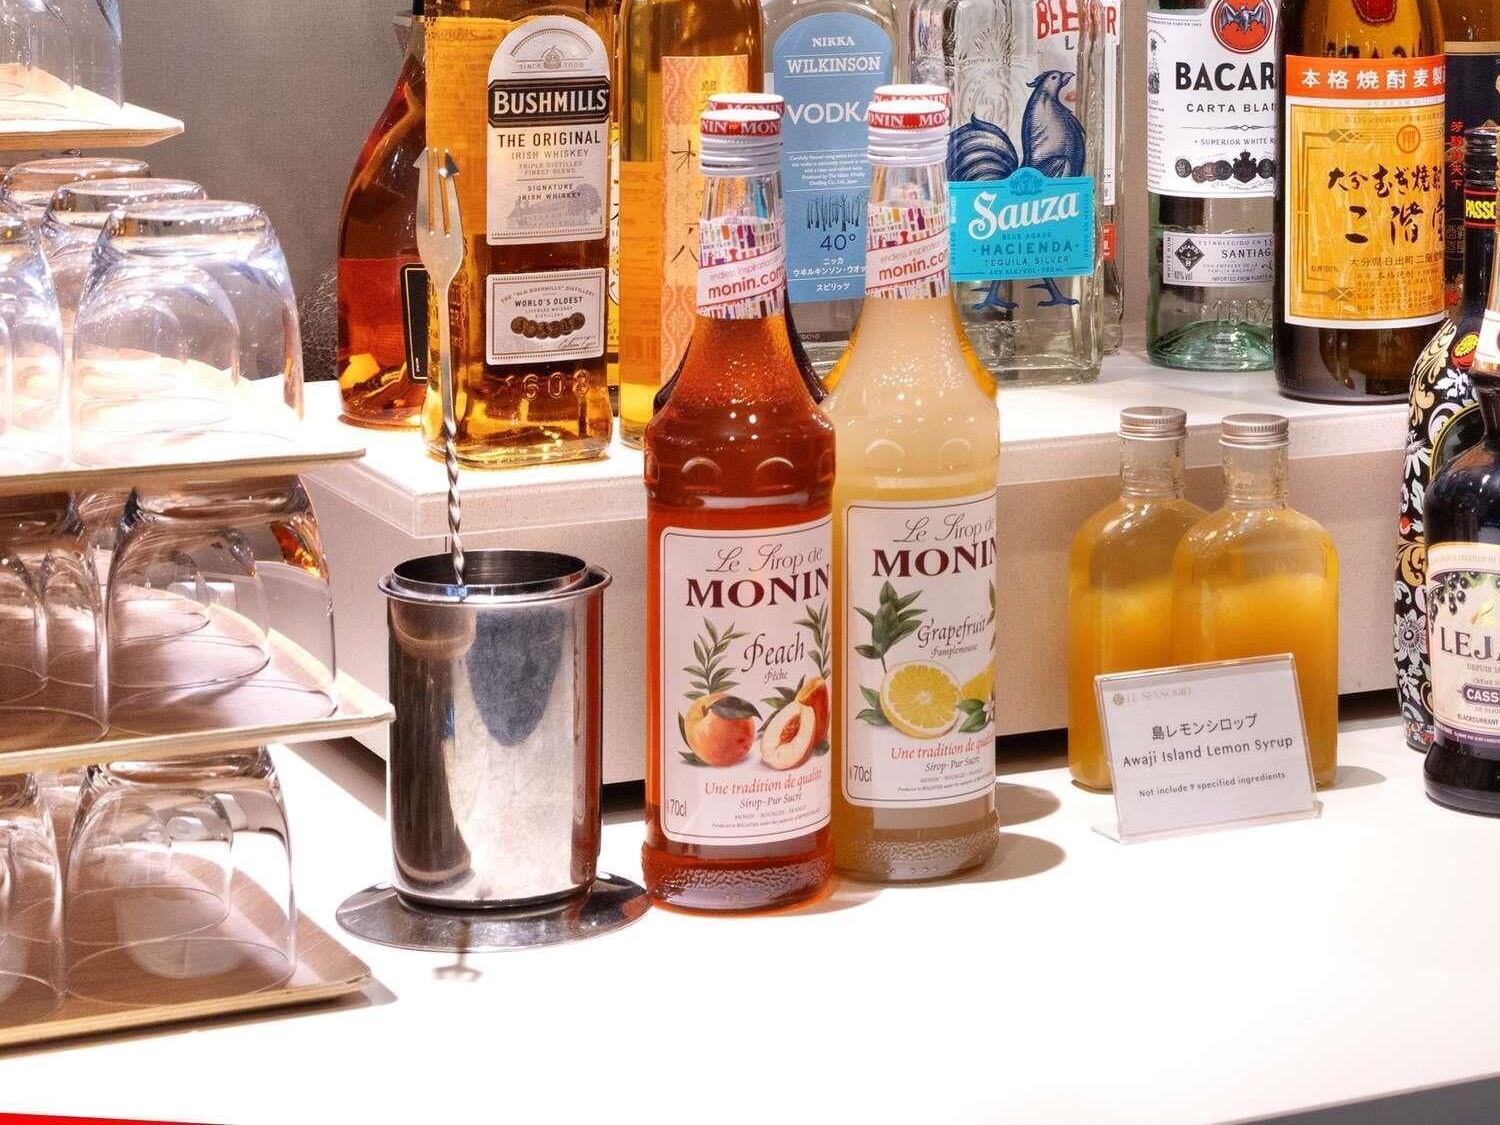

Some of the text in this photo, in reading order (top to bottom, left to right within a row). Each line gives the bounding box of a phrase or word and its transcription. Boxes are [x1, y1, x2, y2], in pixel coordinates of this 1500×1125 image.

[812, 36, 855, 48] NIKKA
[786, 55, 881, 74] WILKINSON
[1175, 61, 1275, 91] BACAR
[1302, 66, 1446, 89] 本格焼酎麦製
[493, 89, 608, 115] BUSHMILLS
[1186, 103, 1274, 113] CARTA BLA
[701, 120, 728, 134] NIN
[498, 130, 601, 148] THE ORIGINAL
[511, 149, 589, 160] IRISH WHISKEY
[527, 183, 573, 192] SIGNATURE
[968, 191, 1080, 240] Sauza
[819, 233, 857, 251] 40°
[980, 240, 1073, 256] HACIENDA
[823, 257, 844, 266] ニッカ
[985, 256, 1069, 266] TEQUILA SILVER
[1221, 248, 1272, 259] SANTIAG
[553, 296, 583, 305] OLDEST
[893, 516, 929, 543] Le
[934, 513, 982, 542] Sirop
[705, 543, 823, 573] Le Sirop de
[686, 563, 830, 608] MONIN
[917, 614, 986, 648] Grapefruit
[741, 632, 805, 672] Peach
[1152, 713, 1258, 741] 島レモンシロップ
[1457, 713, 1499, 726] BLACKCURRANT
[891, 737, 976, 760] Une tradition de
[1123, 735, 1294, 768] Awaji Island Lemon Syrup
[853, 765, 872, 783] 70cl
[704, 781, 729, 795] Une
[732, 776, 784, 794] tradition
[784, 773, 796, 787] de
[1139, 788, 1154, 798] Not
[1157, 783, 1188, 796] include
[1197, 778, 1236, 792] specified
[1238, 771, 1286, 786] ingredients
[670, 798, 688, 818] 70cl
